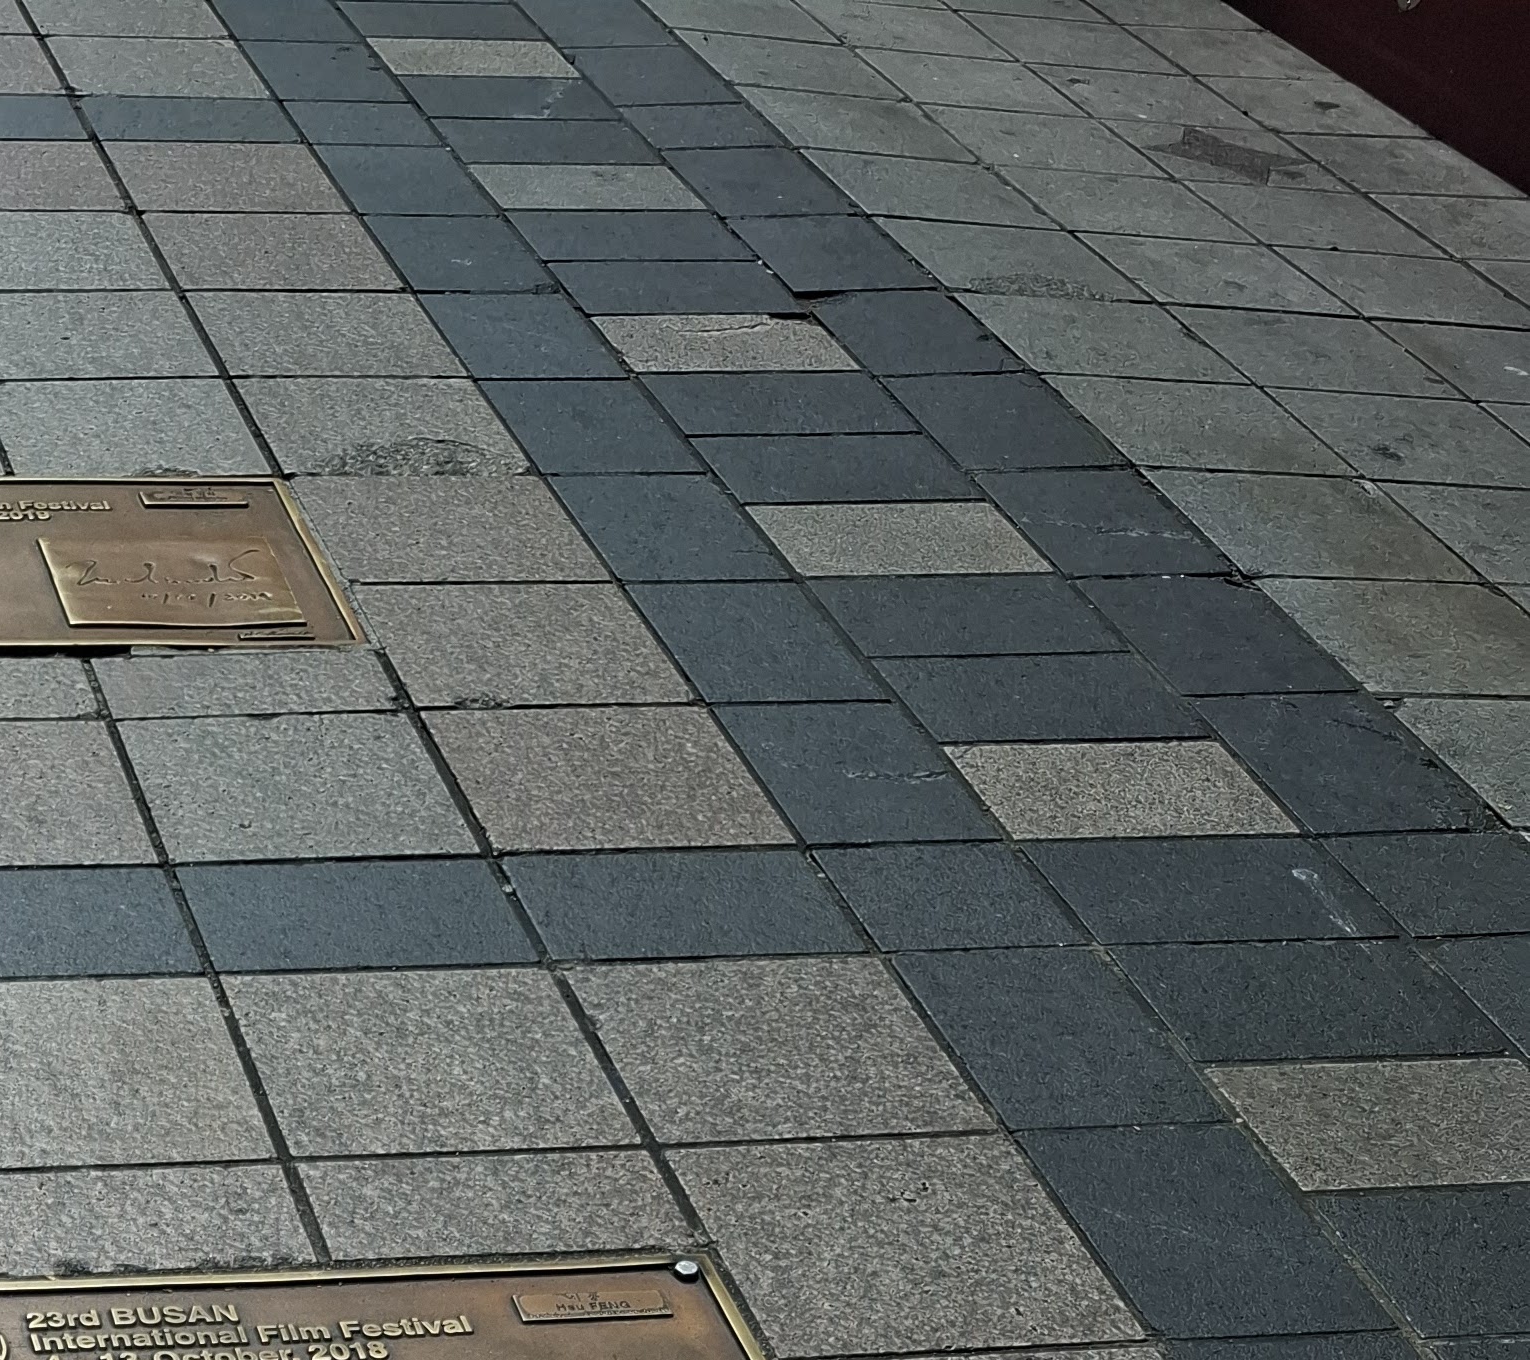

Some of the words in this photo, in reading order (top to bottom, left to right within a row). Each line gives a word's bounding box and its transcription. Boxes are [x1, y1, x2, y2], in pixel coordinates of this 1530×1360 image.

[26, 1309, 100, 1329] 23rd
[110, 1304, 239, 1327] BUSAN
[30, 1326, 247, 1351] International
[256, 1323, 332, 1344] Film
[338, 1315, 475, 1340] Festival
